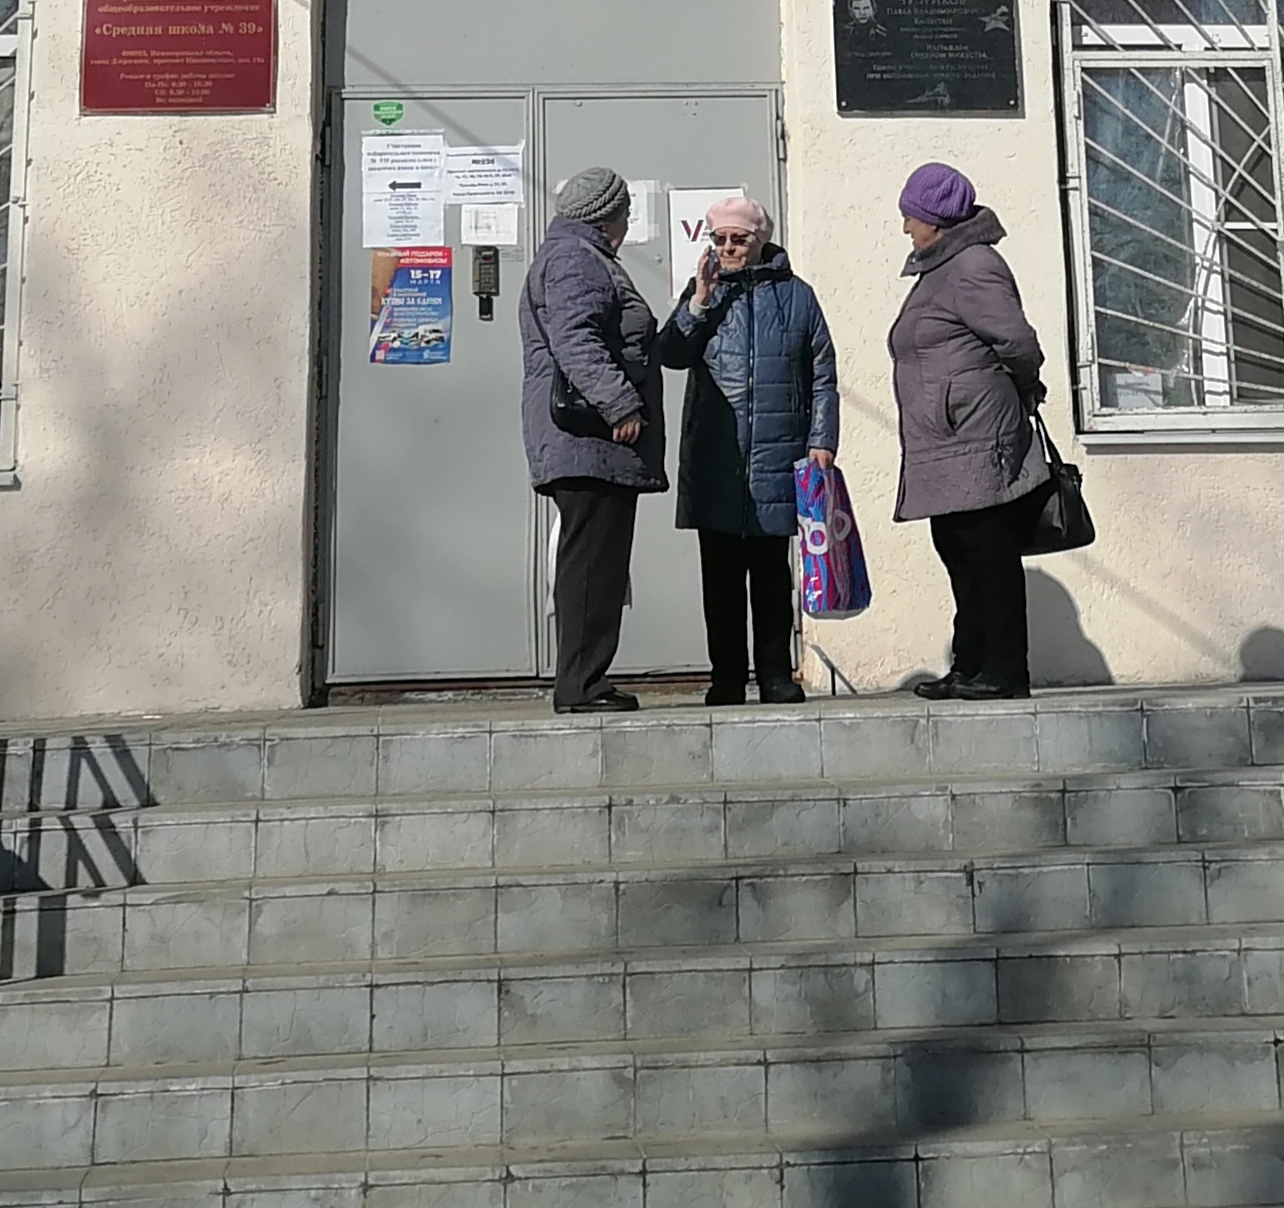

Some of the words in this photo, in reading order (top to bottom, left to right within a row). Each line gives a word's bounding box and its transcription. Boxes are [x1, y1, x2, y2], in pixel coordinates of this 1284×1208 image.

[97, 4, 202, 14] общеобразовательное
[95, 23, 163, 38] «Средняя
[168, 23, 214, 35] школа
[238, 22, 264, 35] 39»
